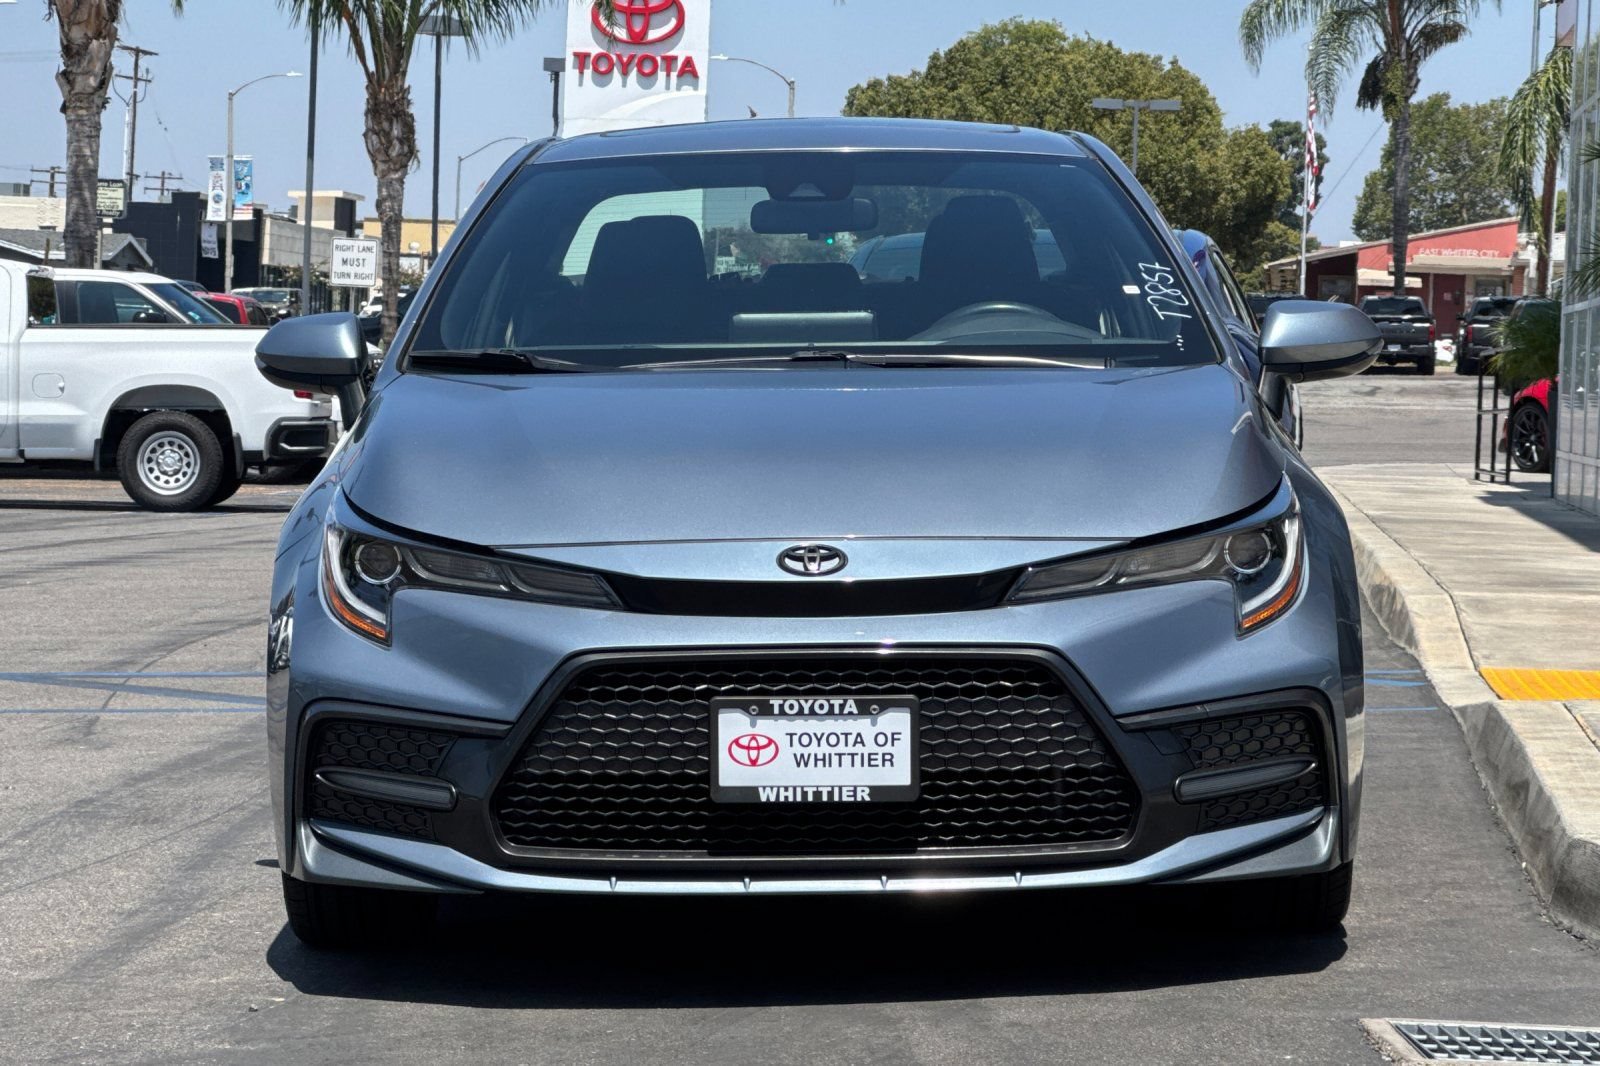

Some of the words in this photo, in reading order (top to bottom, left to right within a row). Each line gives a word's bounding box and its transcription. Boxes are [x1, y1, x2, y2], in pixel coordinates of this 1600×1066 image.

[572, 51, 699, 78] TOYOTA
[335, 244, 355, 252] RIGHT
[358, 245, 375, 253] LANE
[1419, 248, 1439, 256] EAST
[1480, 249, 1500, 258] CITY
[342, 257, 366, 268] MUST
[333, 271, 351, 279] TURN
[354, 272, 374, 281] RIGHT
[1138, 262, 1192, 320] T2857
[769, 699, 858, 715] TOYOTA
[785, 732, 866, 748] TOYOTA
[874, 732, 902, 748] OF
[793, 752, 895, 768] WHITTIER
[758, 786, 871, 802] WHITTIER
